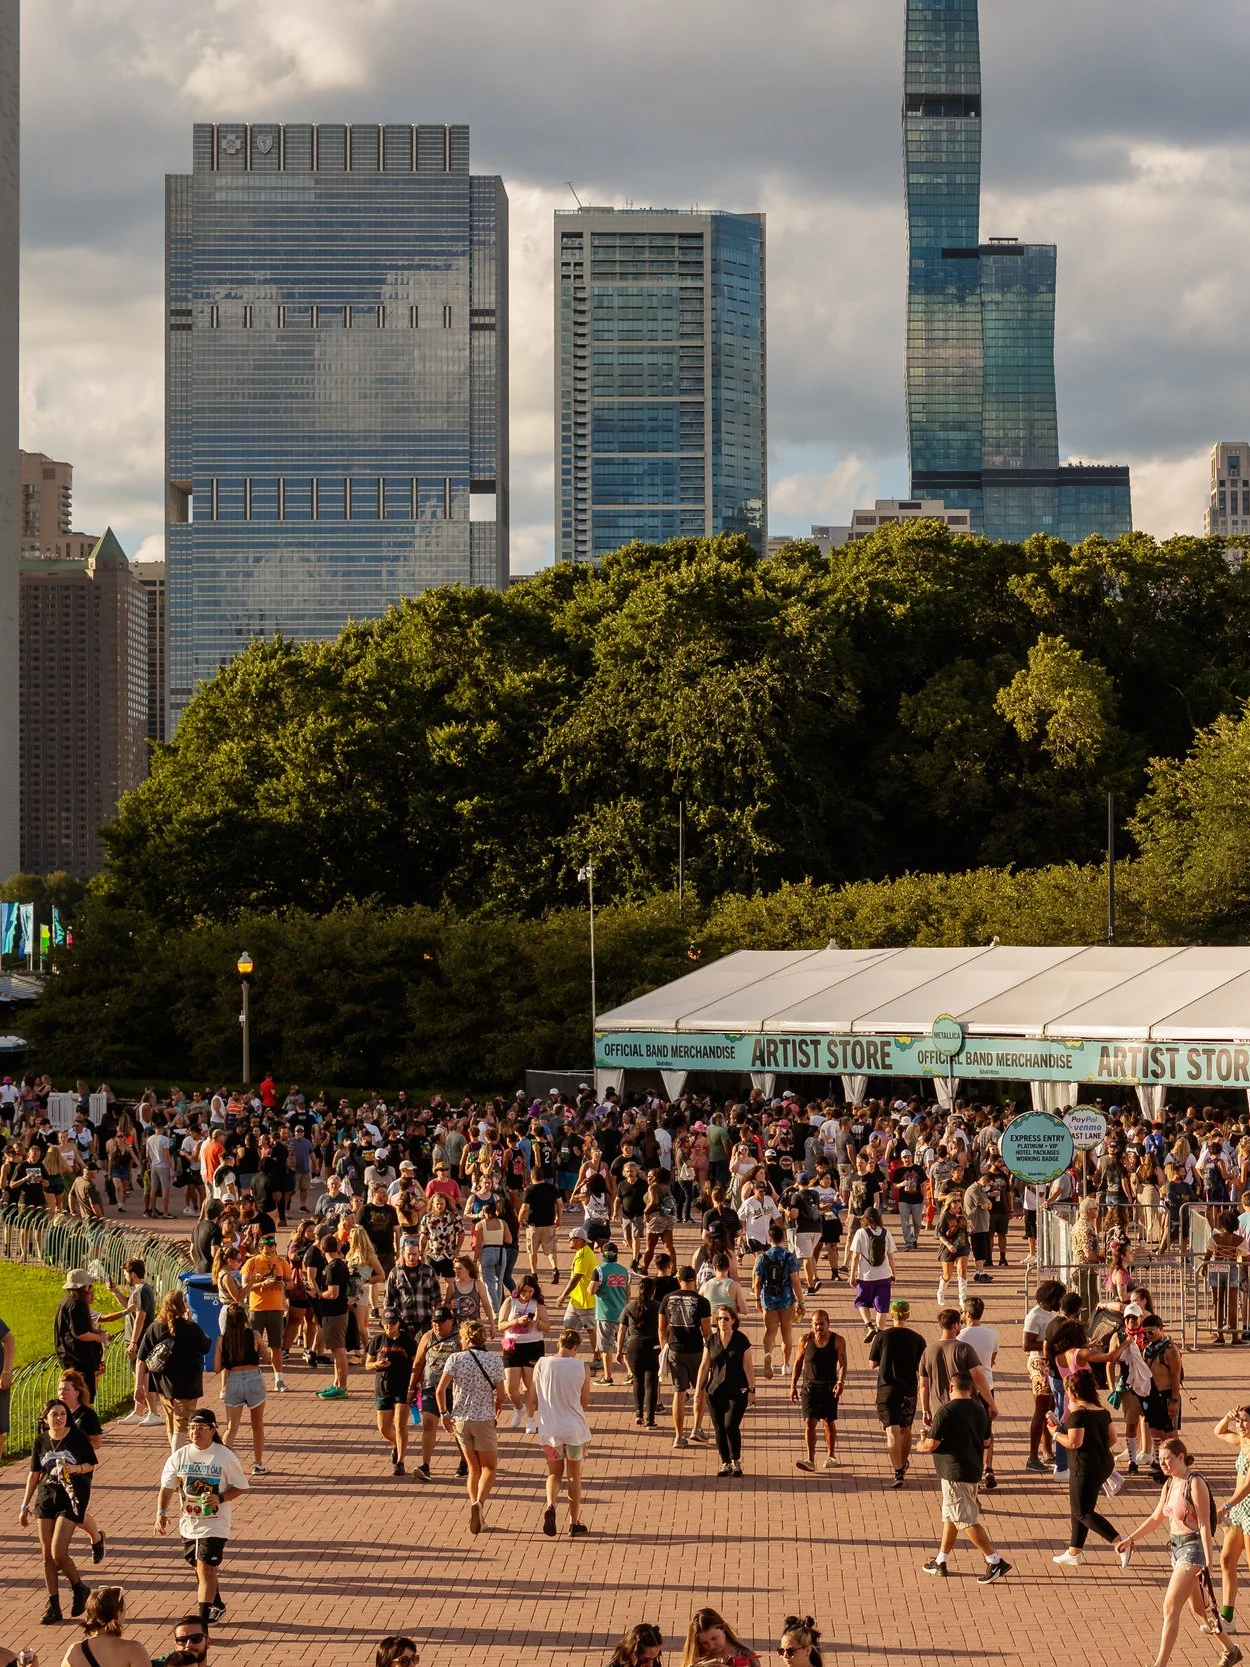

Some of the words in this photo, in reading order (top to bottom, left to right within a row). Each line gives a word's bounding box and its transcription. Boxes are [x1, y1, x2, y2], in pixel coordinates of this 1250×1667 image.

[933, 1031, 961, 1040] METALLICA
[604, 1043, 644, 1058] OFFICIAL
[646, 1044, 669, 1058] BAND
[670, 1044, 736, 1060] MERCHANDISE
[751, 1038, 821, 1068] ARTIST
[827, 1039, 893, 1070] STORE
[965, 1051, 993, 1066] BAND
[996, 1052, 1072, 1069] MERCHANDISE
[1098, 1045, 1179, 1079] ARTIST
[608, 1274, 627, 1287] 22
